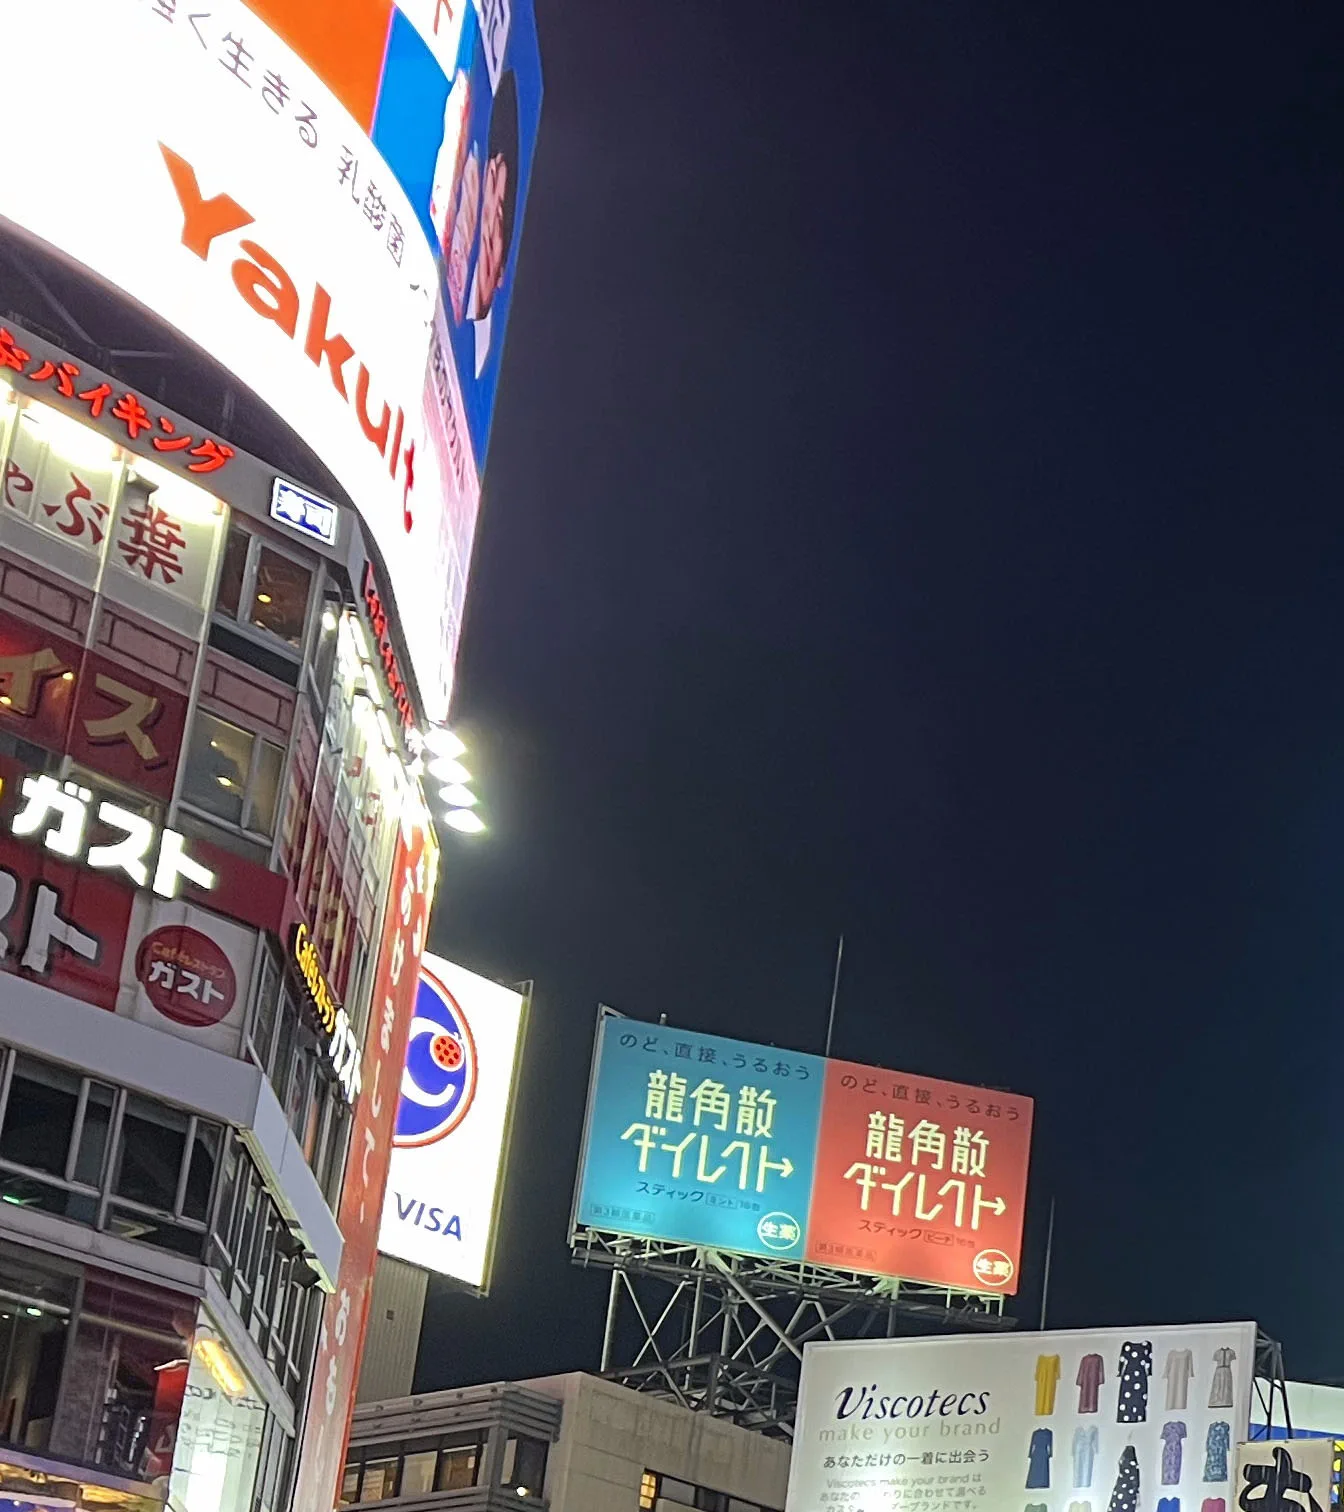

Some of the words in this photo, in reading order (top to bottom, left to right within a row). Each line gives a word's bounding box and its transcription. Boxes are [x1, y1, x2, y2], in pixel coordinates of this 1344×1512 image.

[157, 140, 420, 534] Yakult
[12, 774, 216, 899] ガスト
[148, 960, 225, 1005] ガスト
[619, 1031, 811, 1082] のど、直接、うるおう
[645, 1068, 778, 1139] 龍角散
[840, 1072, 1020, 1122] のど、直接、うるおう
[620, 1122, 795, 1193] ダイレクト
[866, 1110, 990, 1178] 龍角散
[394, 1191, 464, 1243] VISA
[636, 1181, 704, 1203] スティック
[843, 1161, 1007, 1231] ダイレクト
[858, 1219, 924, 1240] スティック
[835, 1383, 991, 1420] Viscotecs
[818, 1423, 874, 1441] make
[883, 1425, 931, 1444] your
[939, 1417, 1001, 1437] brand
[822, 1449, 991, 1468] あなただけの一着に出会う
[937, 1473, 970, 1484] brand
